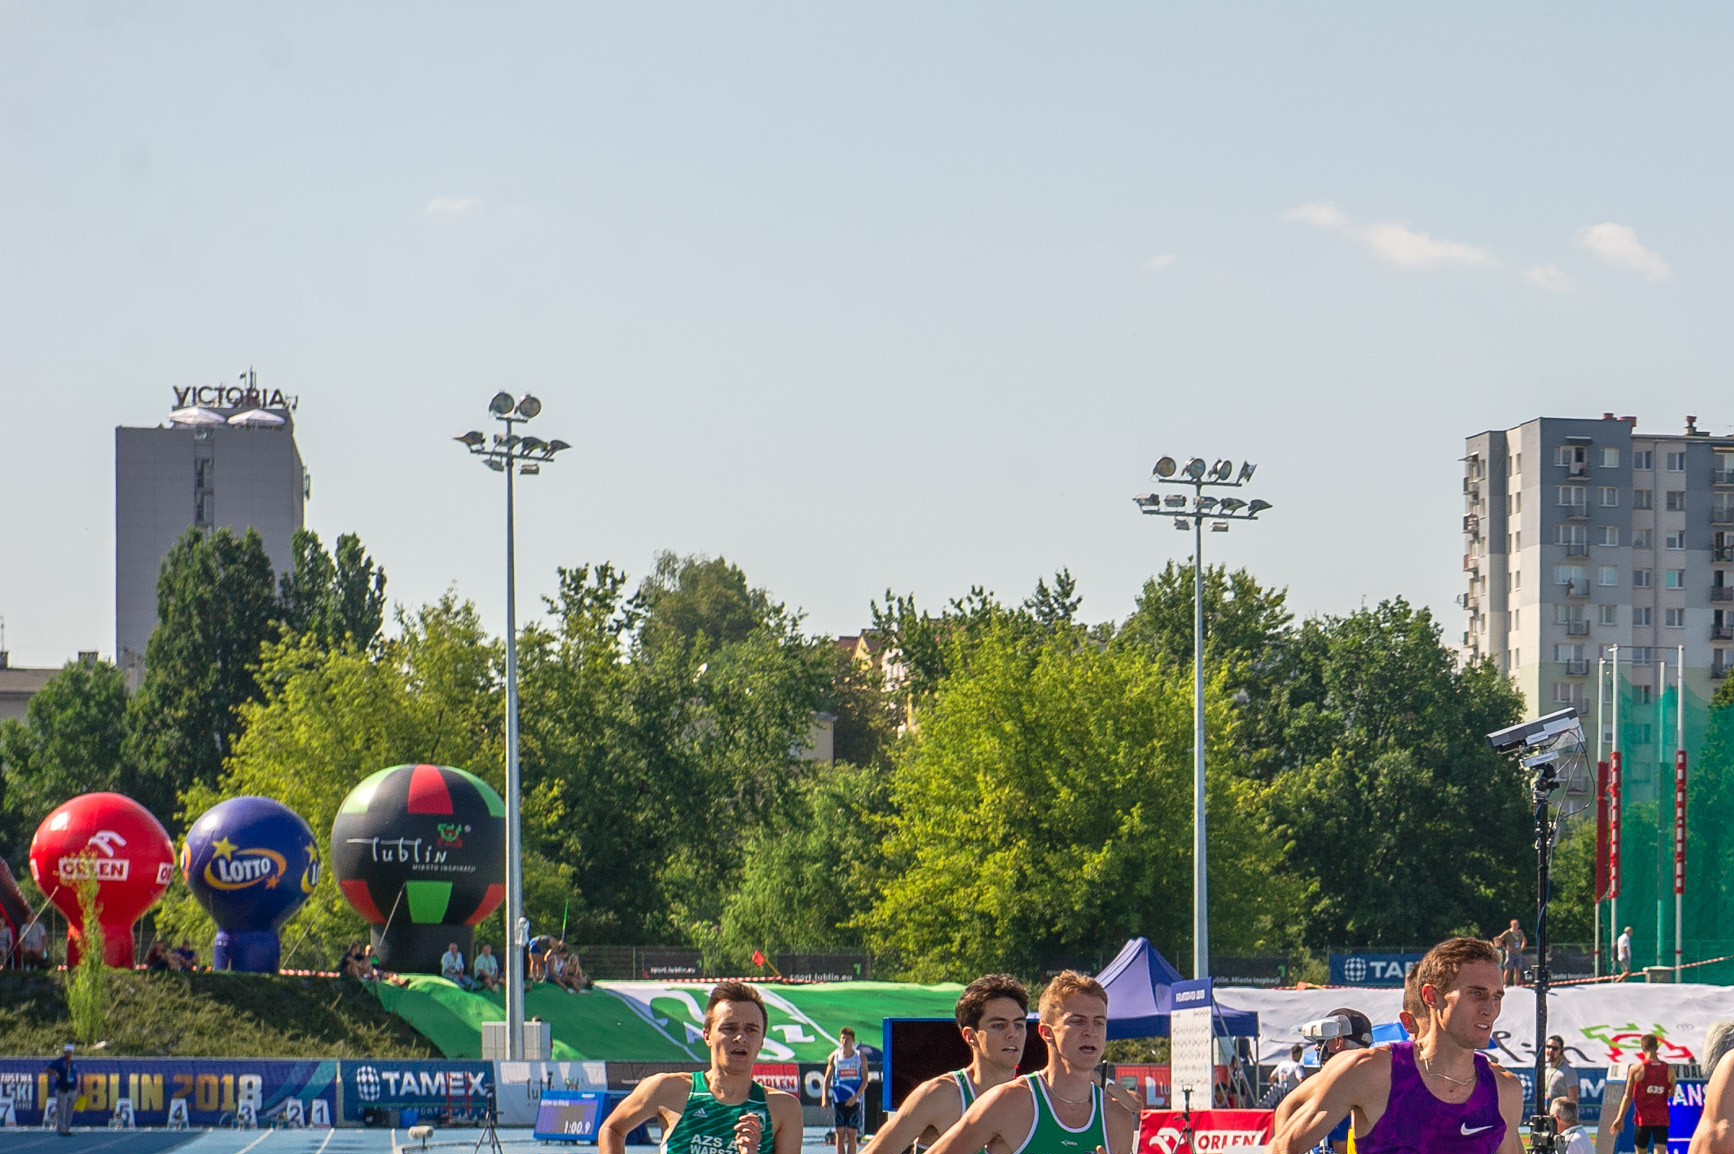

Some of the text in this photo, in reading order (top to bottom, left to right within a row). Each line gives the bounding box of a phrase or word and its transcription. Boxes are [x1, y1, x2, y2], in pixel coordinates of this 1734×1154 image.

[173, 385, 287, 409] VICTORIA
[370, 836, 448, 863] lublin
[61, 861, 125, 878] OREN
[218, 857, 271, 883] LOTTO
[381, 1071, 487, 1097] TAMEX
[690, 1133, 723, 1147] AZS
